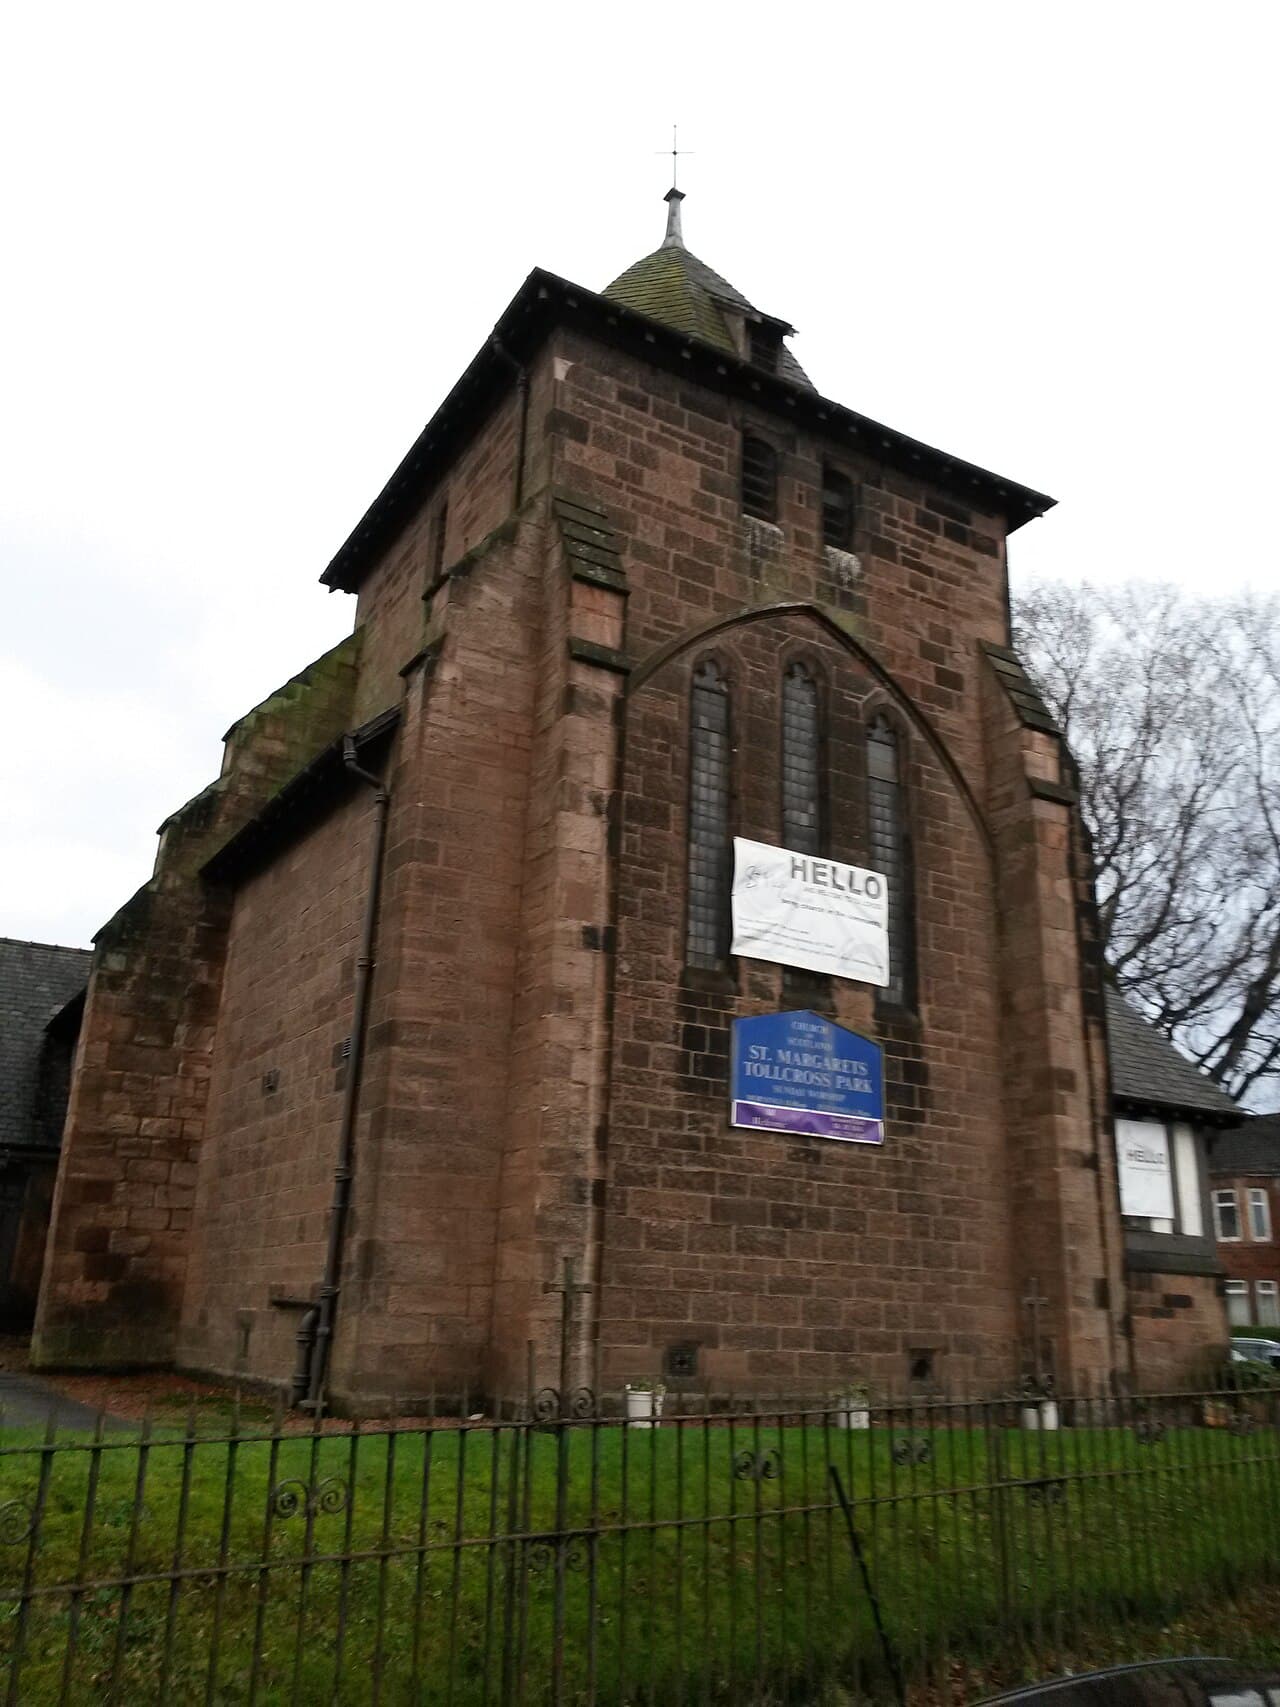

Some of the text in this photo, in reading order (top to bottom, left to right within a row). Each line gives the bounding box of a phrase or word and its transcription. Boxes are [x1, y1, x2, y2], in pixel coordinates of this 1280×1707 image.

[790, 856, 881, 899] HELLO
[744, 1061, 873, 1093] TOLLCROSS PARK
